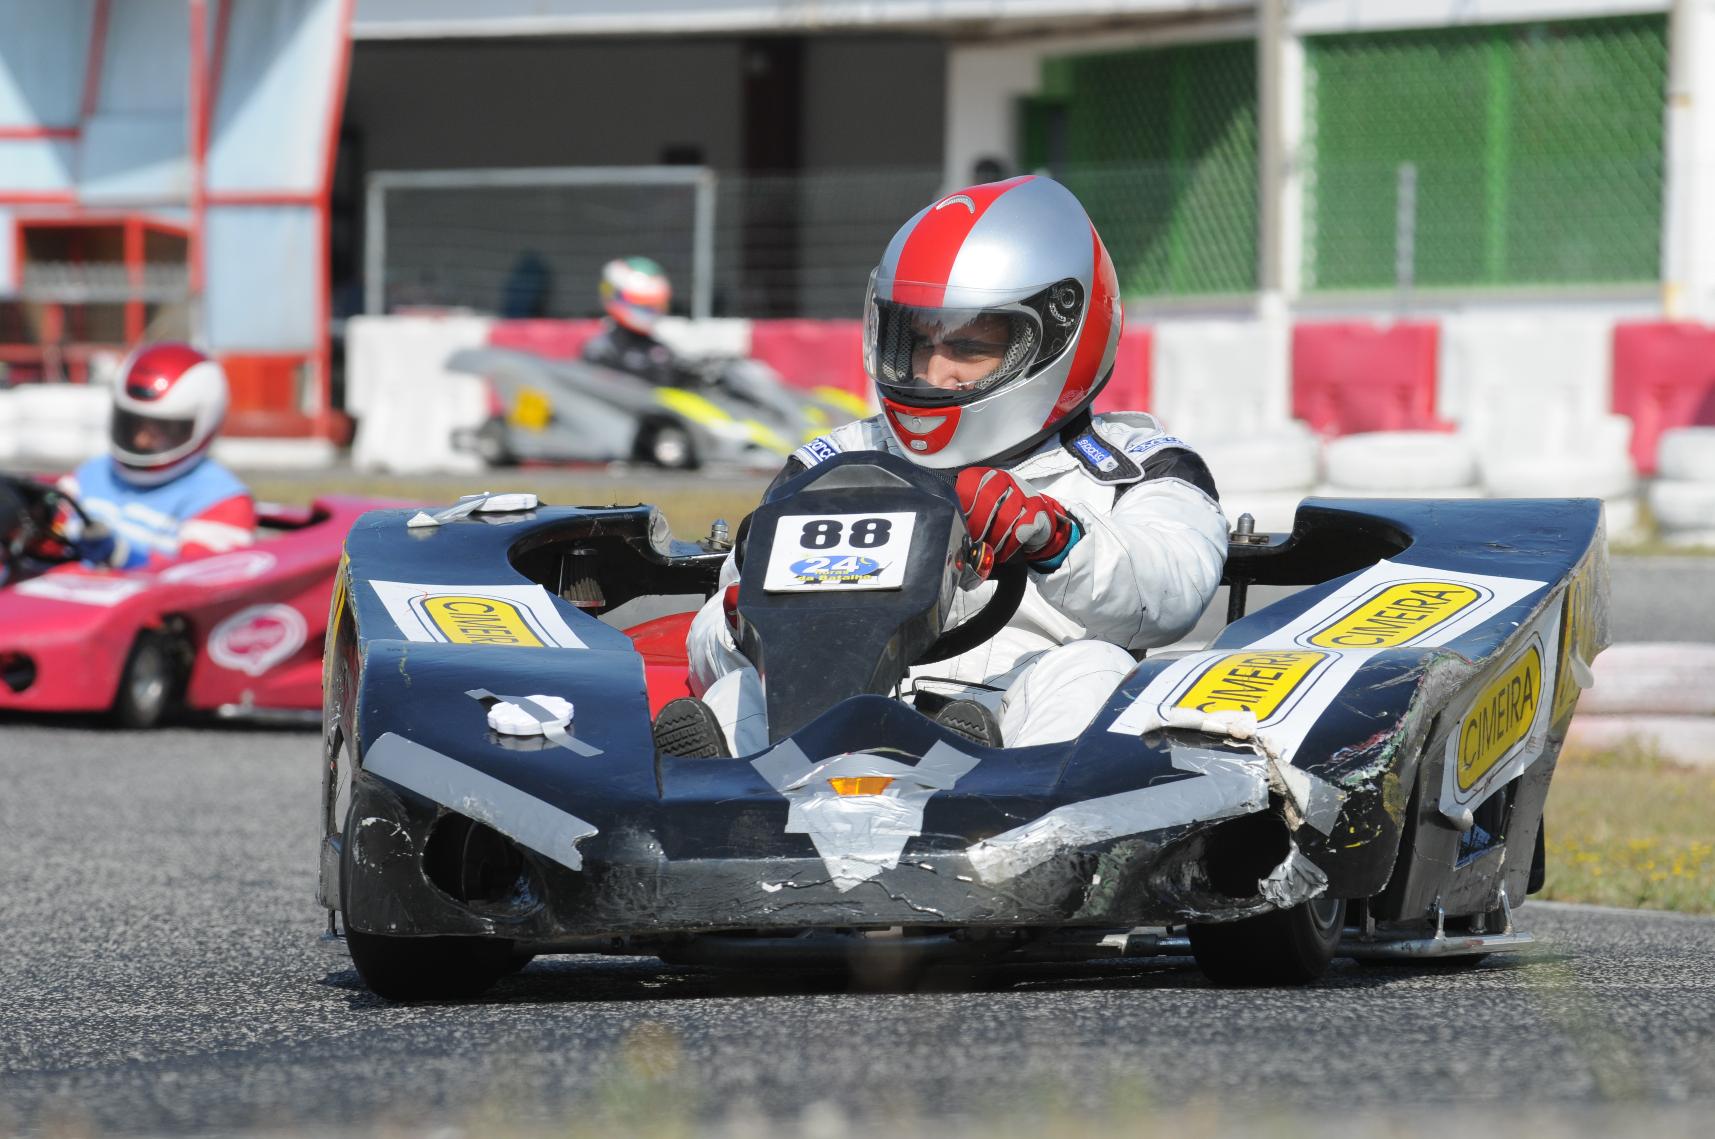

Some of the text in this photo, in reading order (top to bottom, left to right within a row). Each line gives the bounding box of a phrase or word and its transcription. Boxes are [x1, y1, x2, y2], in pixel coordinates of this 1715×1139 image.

[799, 518, 893, 550] 88
[802, 556, 860, 575] 24
[442, 601, 519, 645] CIMEIR
[1331, 589, 1466, 647] CIMEIRA
[1463, 665, 1535, 769] CIMEIRA
